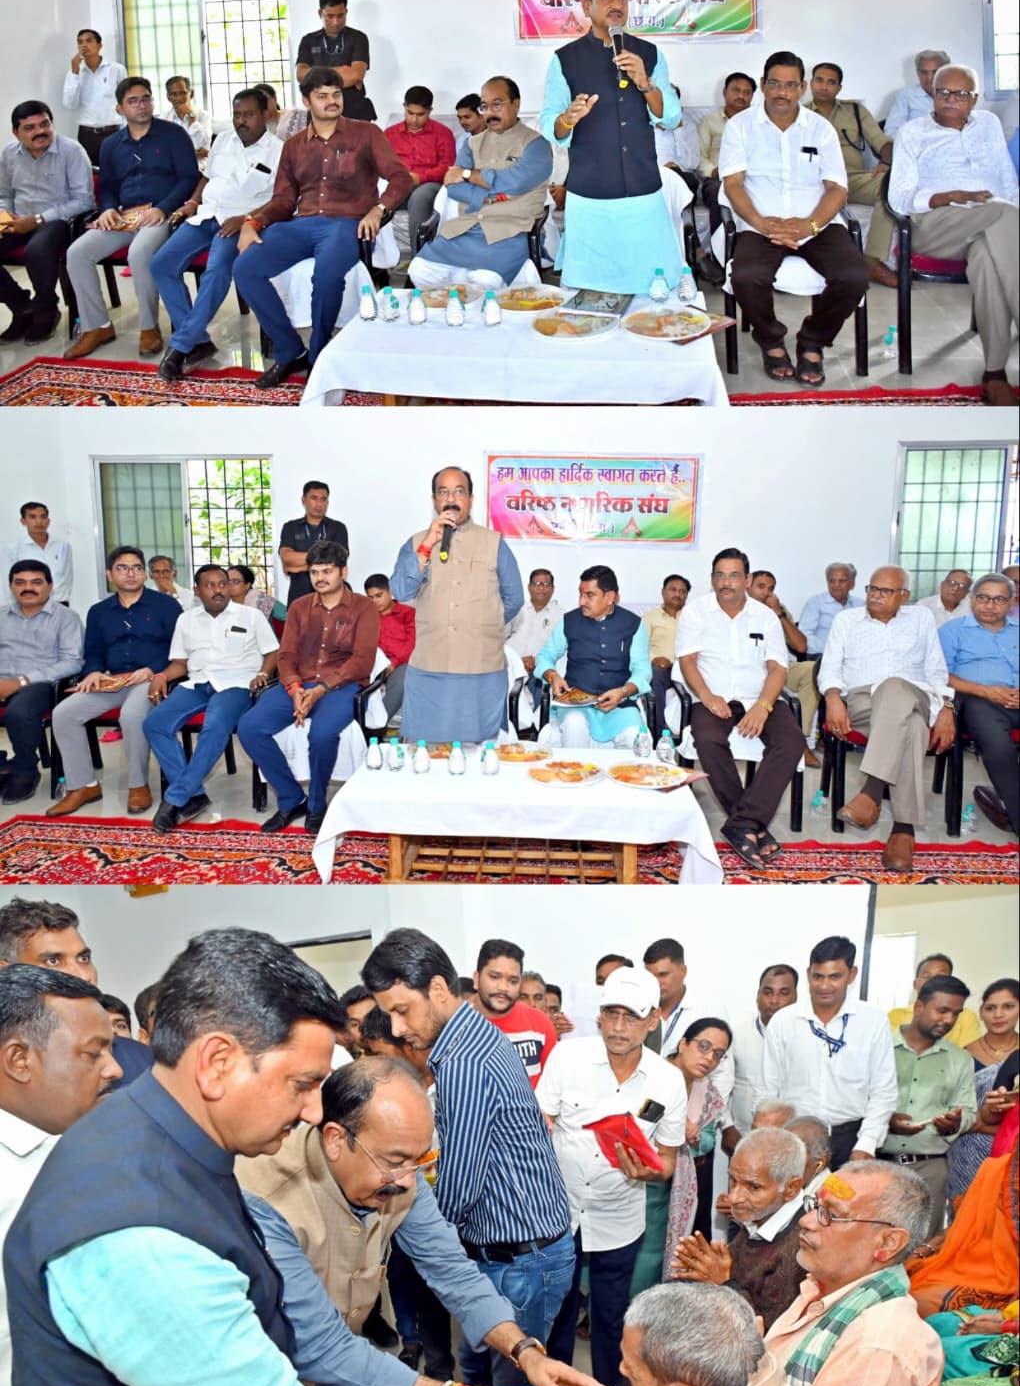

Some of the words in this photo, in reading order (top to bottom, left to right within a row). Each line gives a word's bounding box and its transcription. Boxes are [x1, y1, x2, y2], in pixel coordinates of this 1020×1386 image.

[496, 466, 514, 482] हम
[518, 466, 555, 483] आपका
[558, 462, 594, 484] हार्दिक
[597, 467, 636, 484] स्वागत
[639, 464, 666, 484] करते
[505, 489, 556, 512] वरिष्ठ
[636, 493, 671, 514] संघ
